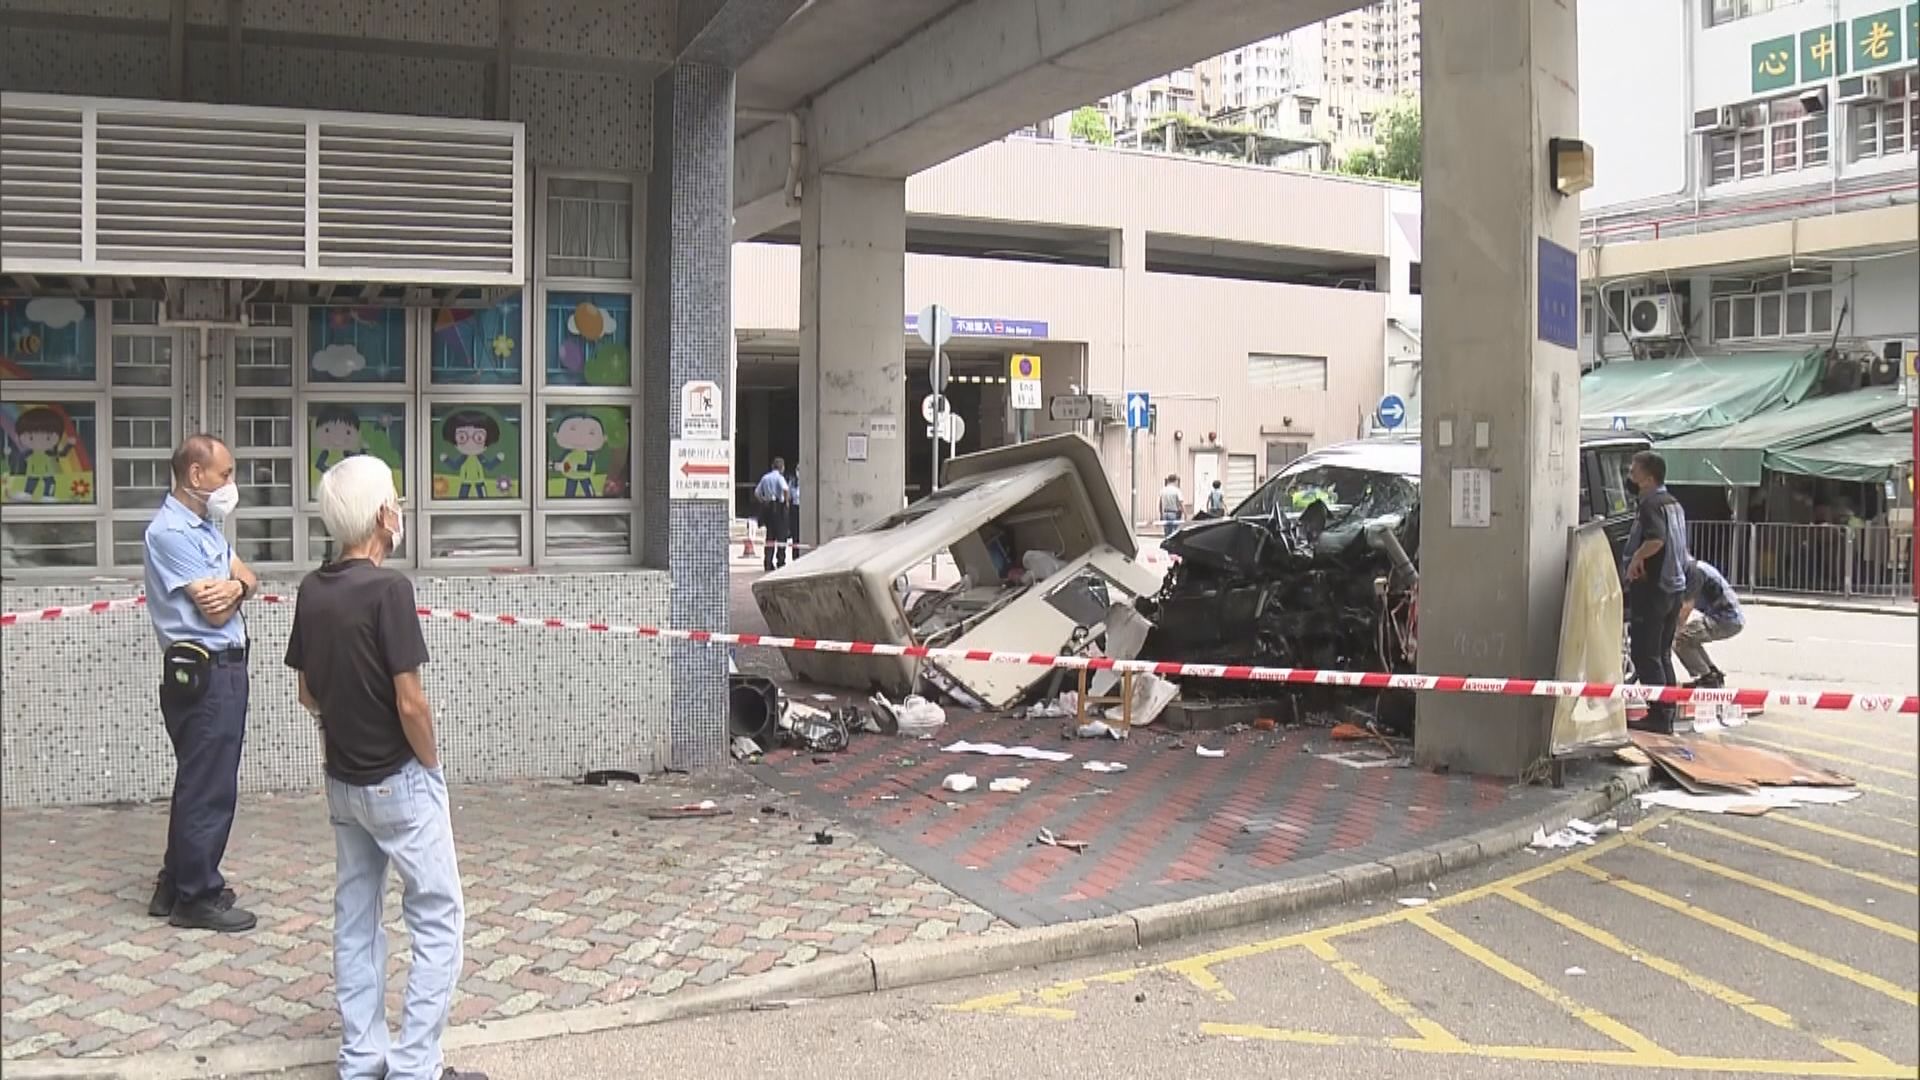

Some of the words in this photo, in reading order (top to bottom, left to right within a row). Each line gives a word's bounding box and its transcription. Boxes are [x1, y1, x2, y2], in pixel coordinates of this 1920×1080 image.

[1019, 382, 1034, 392] End
[1464, 682, 1503, 692] DANGER
[1693, 691, 1733, 702] DANGER
